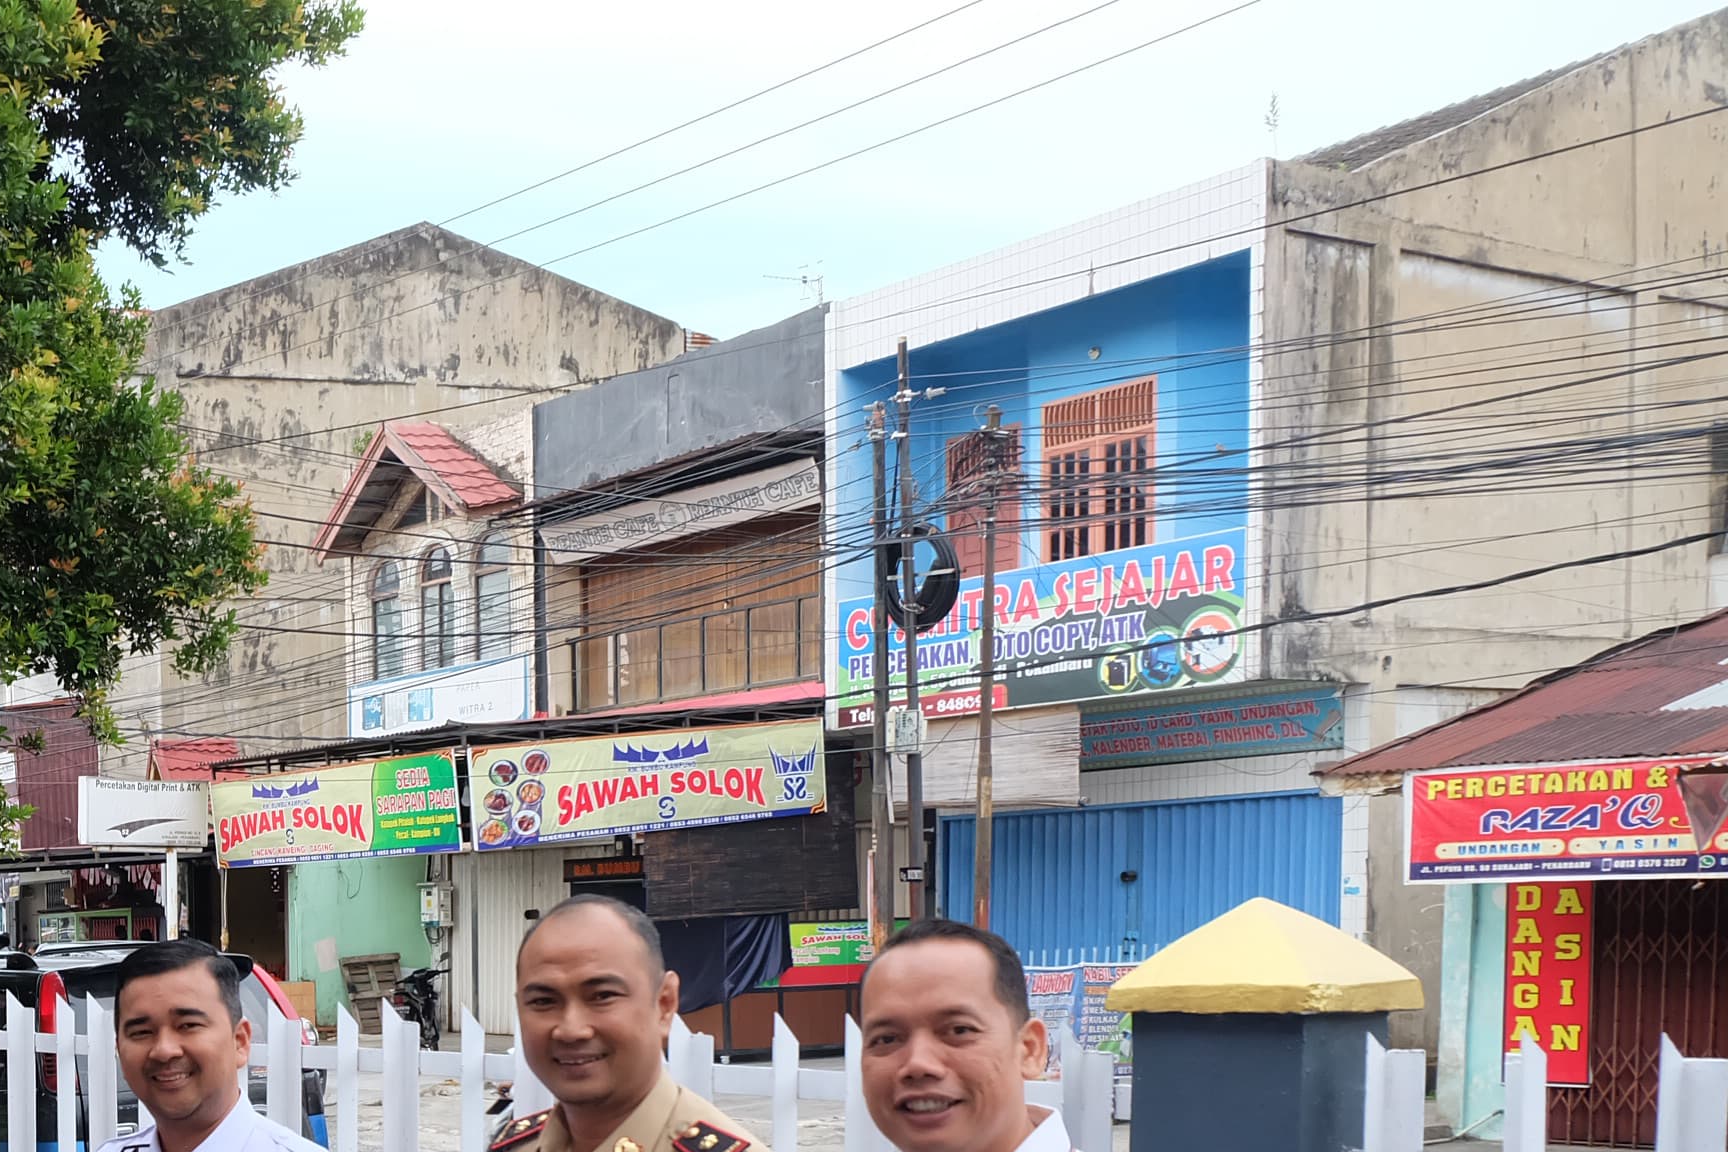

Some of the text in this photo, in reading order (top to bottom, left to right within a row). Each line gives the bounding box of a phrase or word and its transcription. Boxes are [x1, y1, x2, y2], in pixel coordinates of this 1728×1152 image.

[764, 471, 818, 502] CAFE
[613, 514, 659, 539] CAFE
[917, 578, 1041, 642] ITRA
[1053, 544, 1235, 619] SEJAJAR
[848, 611, 1148, 682] PECEAKAN, OTO COPY, ATK
[1080, 722, 1108, 738] ETAK
[1240, 700, 1320, 721] UNDANGAN,
[1282, 721, 1307, 738] DLL
[95, 779, 201, 794] Percetakan Digital Print & ATK
[395, 766, 431, 790] SEDIA
[1426, 766, 1668, 801] PERCETAKAN &
[376, 787, 457, 816] SARAPAN PAGI
[557, 767, 766, 827] SAWAH SOLOK
[219, 803, 367, 854] SAWAH SOLOK
[1457, 842, 1542, 856] UNDANGAN
[801, 933, 869, 945] SAWAH SOL
[1549, 887, 1585, 1051] ASIN
